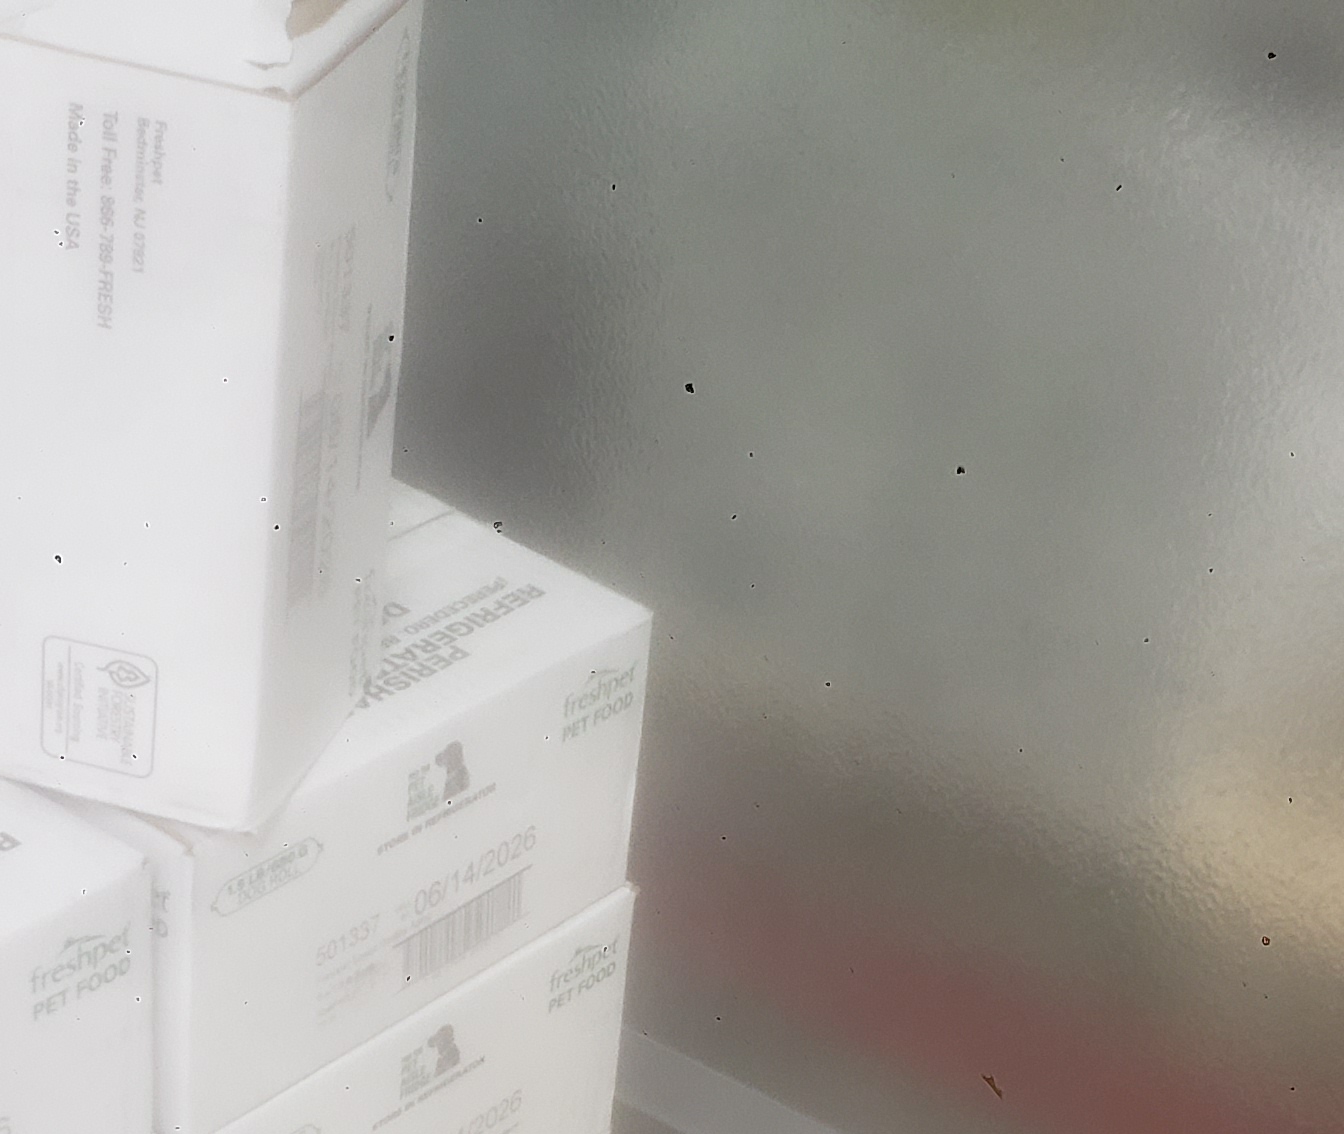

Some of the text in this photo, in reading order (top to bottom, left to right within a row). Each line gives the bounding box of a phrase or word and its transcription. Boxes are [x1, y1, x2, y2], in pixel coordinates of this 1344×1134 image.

[67, 102, 84, 153] Made
[102, 110, 118, 141] Toll
[100, 148, 117, 188] Free:
[151, 119, 168, 186] Freshpet
[65, 178, 81, 208] the
[65, 212, 80, 251] USA
[562, 661, 639, 718] freshpet
[561, 692, 634, 744] PET FOOD
[315, 825, 538, 967] 501337 06/14/2026
[29, 921, 132, 995] freshpet
[548, 935, 620, 992] freshpet
[32, 956, 132, 1021] PET FOOD
[548, 961, 616, 1014] PET FOOD
